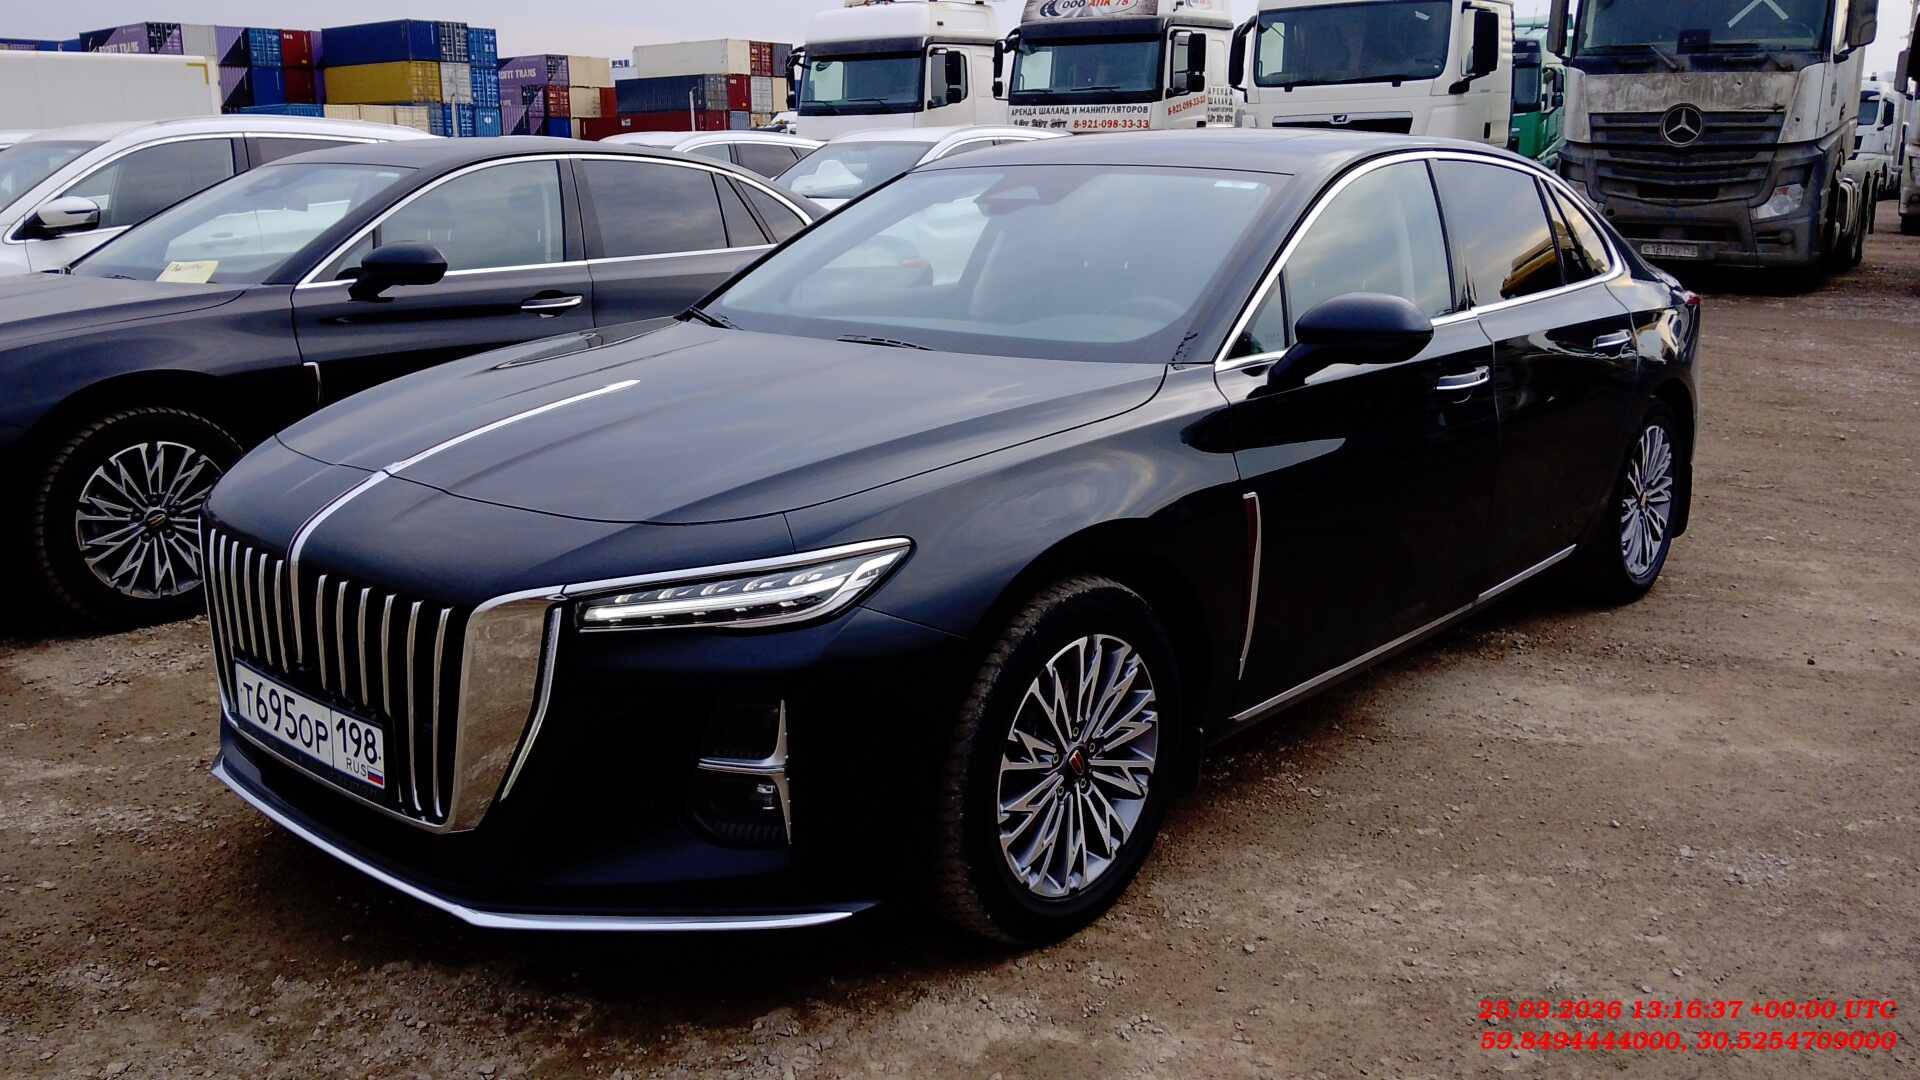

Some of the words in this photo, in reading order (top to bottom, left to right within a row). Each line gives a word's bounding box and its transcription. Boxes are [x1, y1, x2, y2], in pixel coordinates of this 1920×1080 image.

[1062, 0, 1086, 8] ООО
[1011, 108, 1037, 116] АРЕНДА
[1038, 107, 1070, 115] ШАЛАНД
[1079, 105, 1149, 114] МАНИПУЛЯТОРОВ
[1073, 119, 1149, 129] 8-921-098-33-33
[336, 717, 378, 765] 198
[346, 757, 368, 778] RUS
